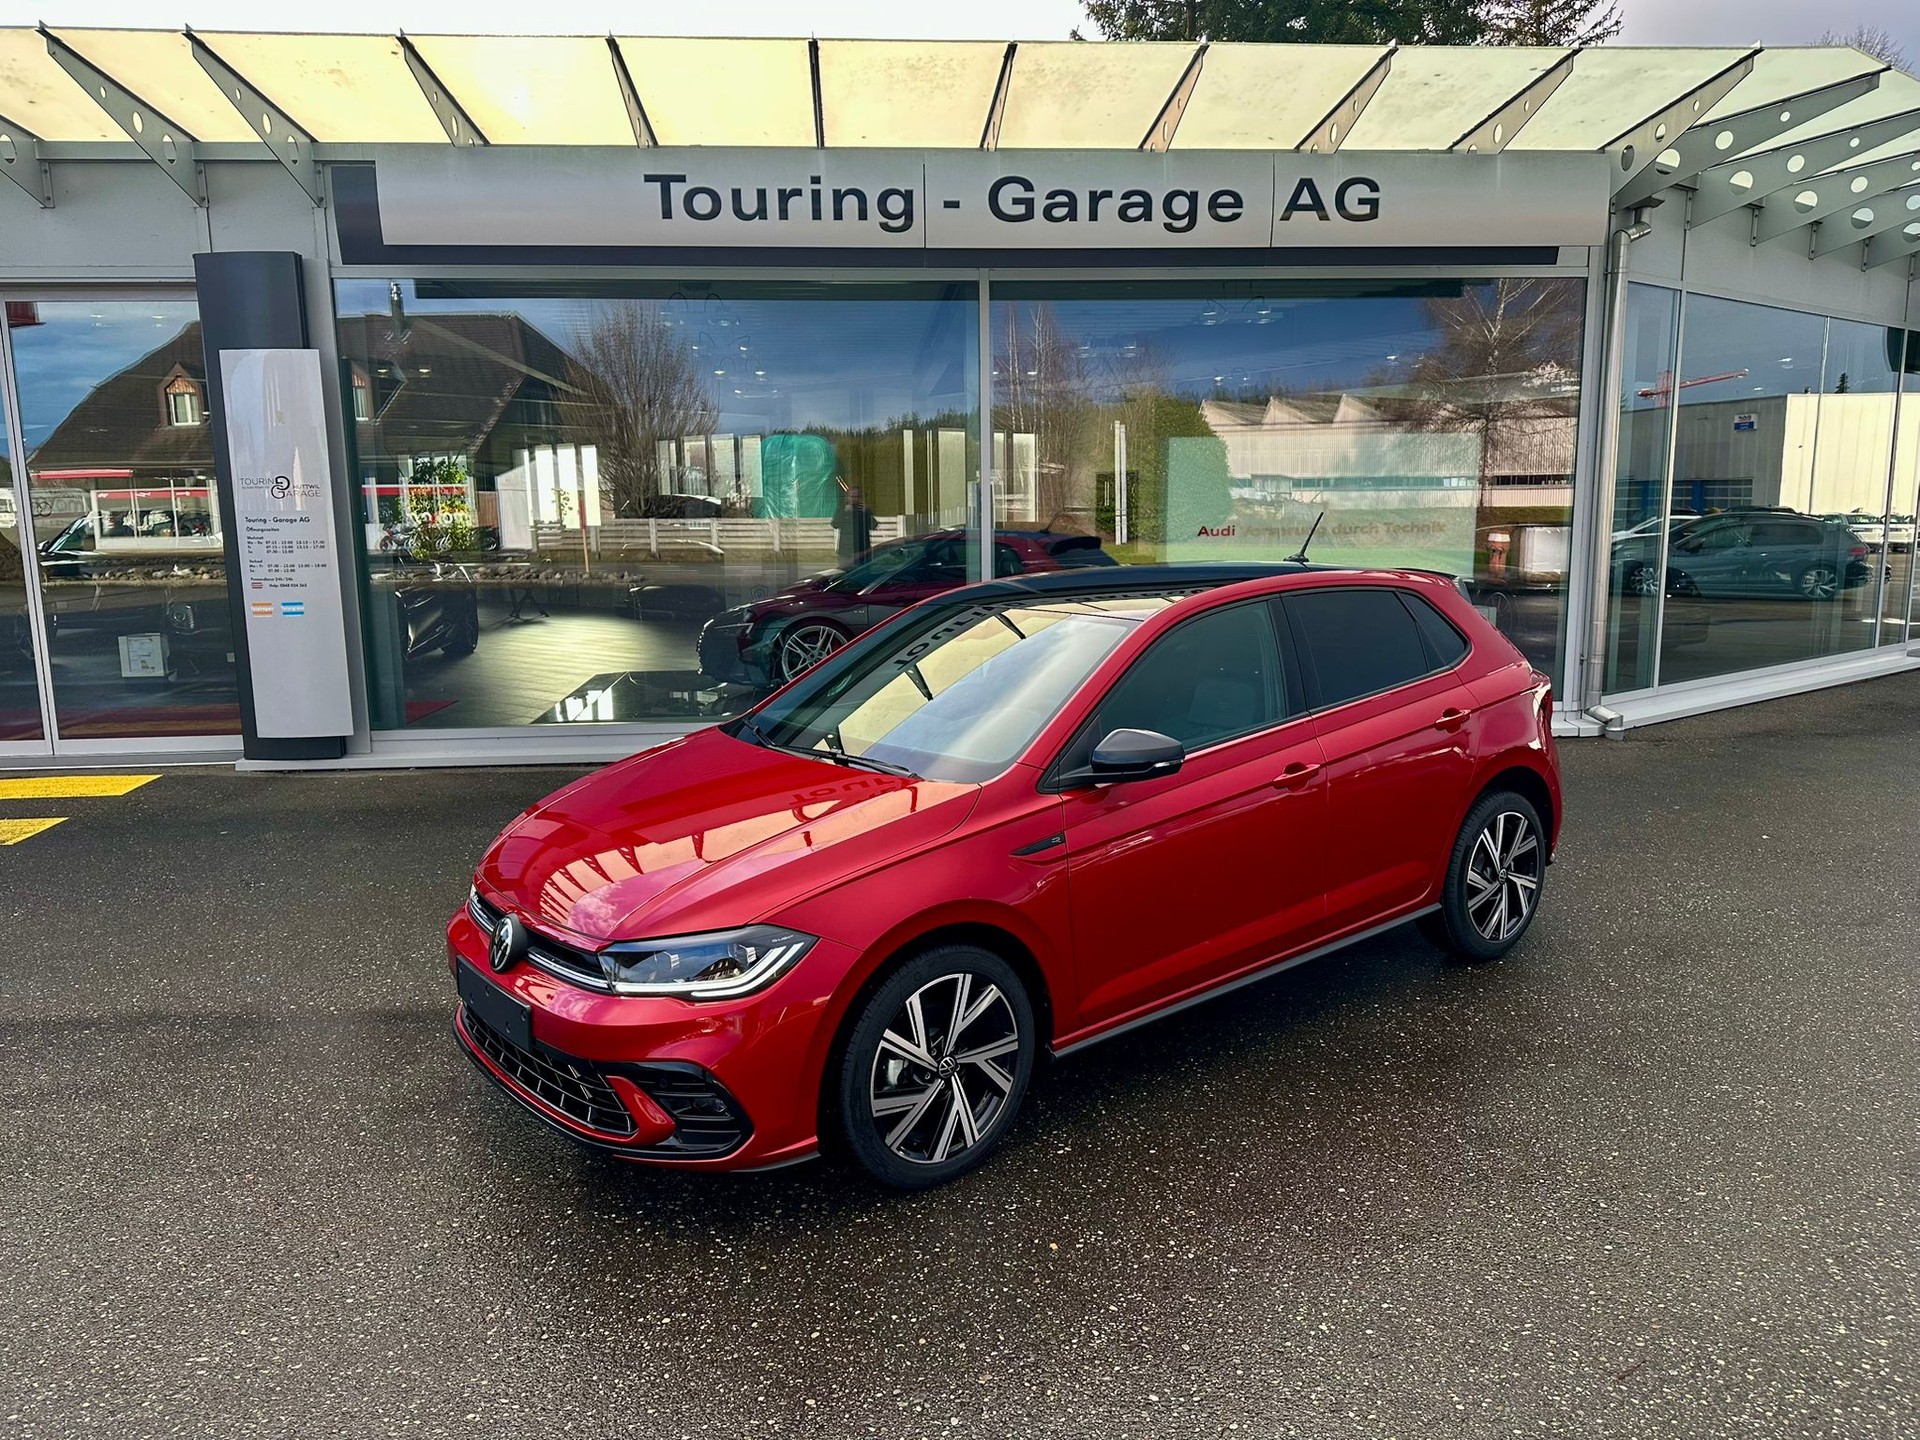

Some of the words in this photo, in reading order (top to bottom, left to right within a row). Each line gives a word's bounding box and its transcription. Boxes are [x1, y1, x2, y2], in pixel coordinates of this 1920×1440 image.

[643, 173, 914, 234] Touring
[987, 175, 1244, 235] Garage
[1278, 176, 1382, 223] AG
[245, 516, 267, 524] Touring
[272, 516, 298, 524] Garage
[1197, 525, 1236, 537] Audi
